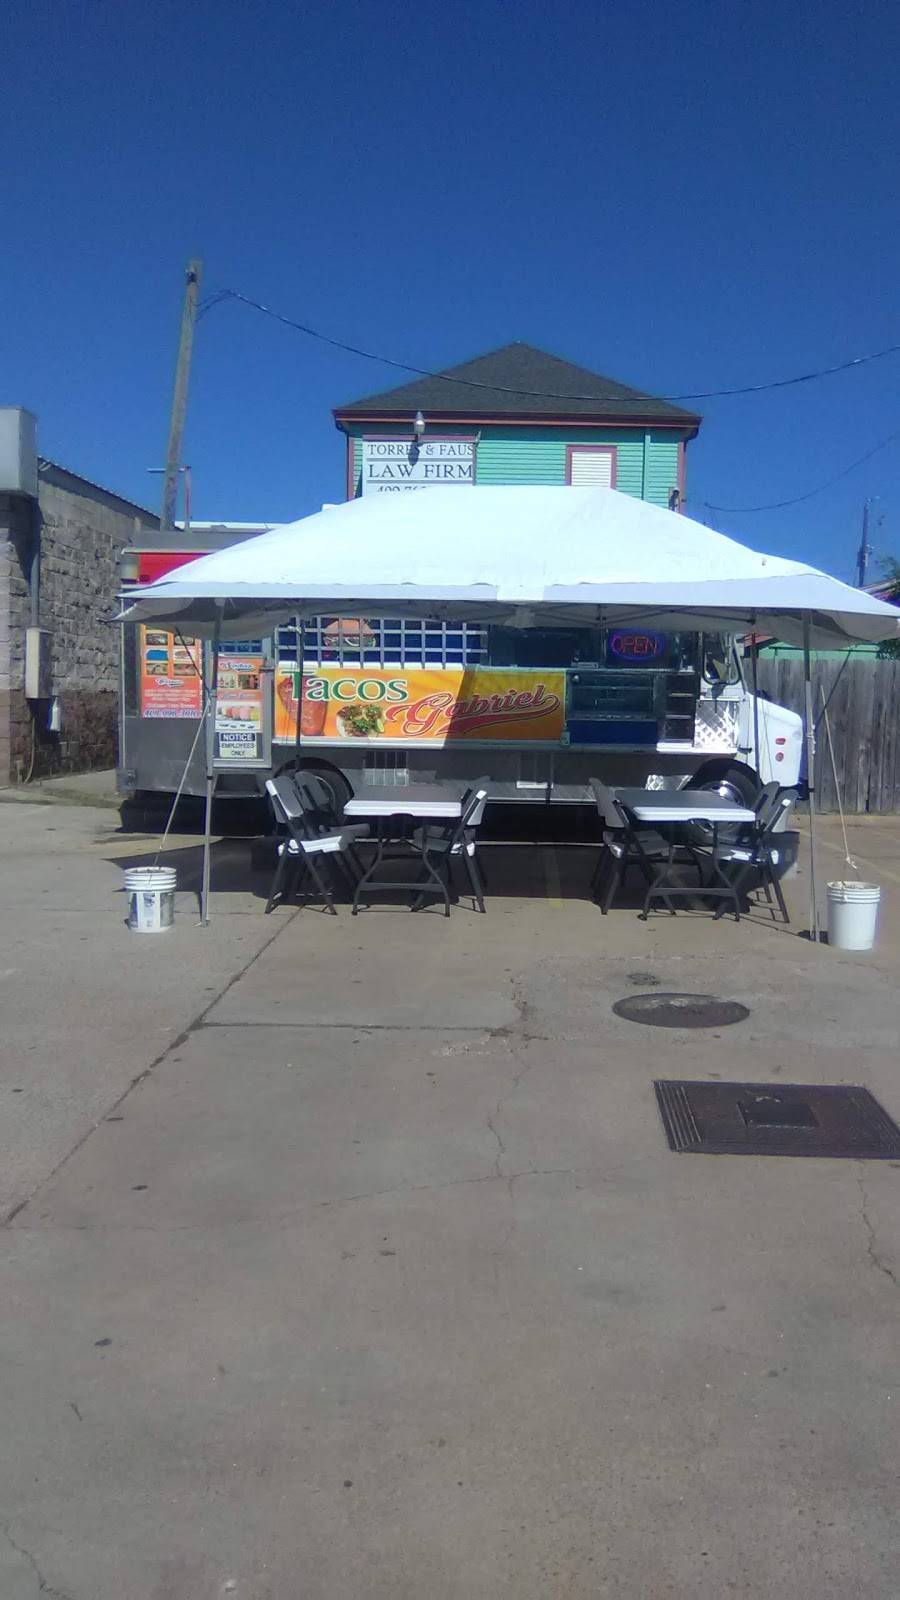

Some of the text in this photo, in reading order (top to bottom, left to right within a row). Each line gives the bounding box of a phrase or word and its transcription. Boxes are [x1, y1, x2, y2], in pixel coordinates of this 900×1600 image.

[425, 444, 434, 456] &
[368, 464, 472, 478] LAW FIRM
[611, 635, 658, 655] OPEN
[280, 669, 409, 702] Tacos
[385, 683, 561, 737] Gabriel
[222, 733, 253, 741] NOTICE
